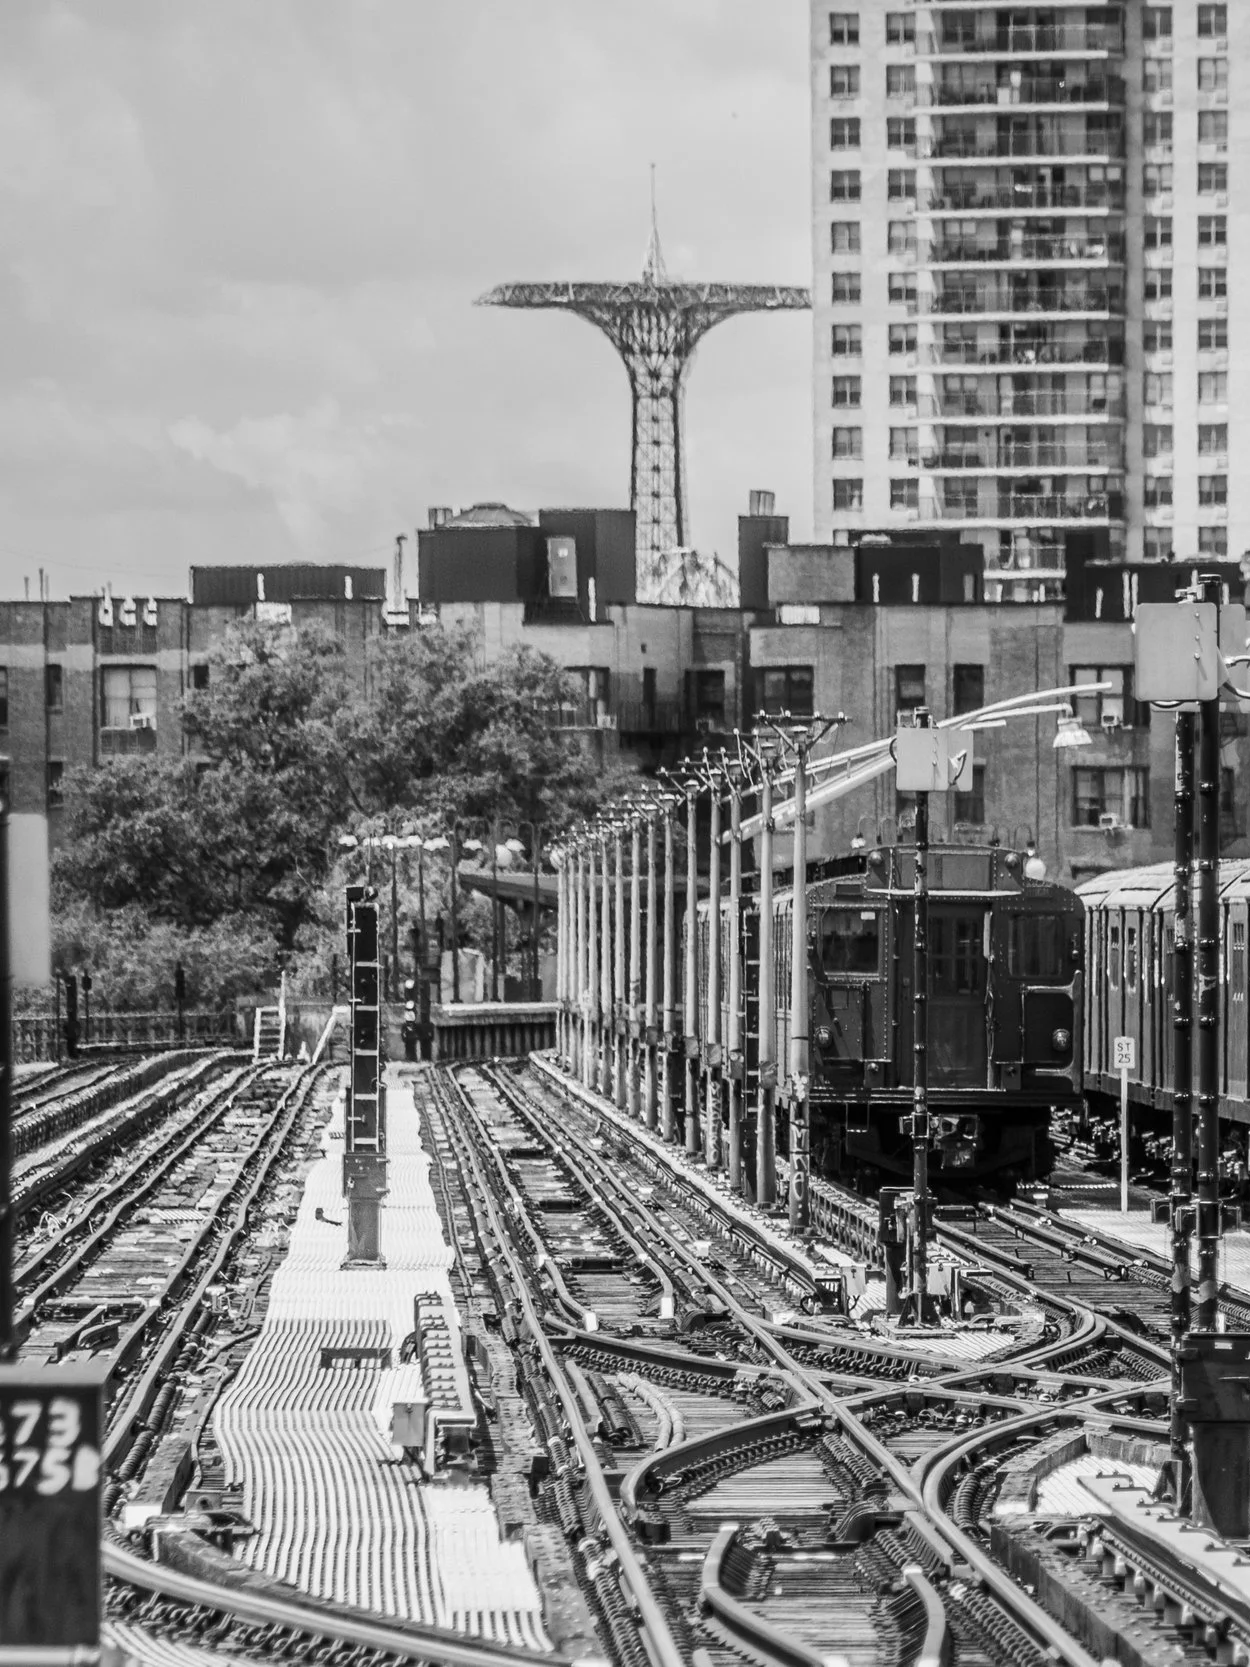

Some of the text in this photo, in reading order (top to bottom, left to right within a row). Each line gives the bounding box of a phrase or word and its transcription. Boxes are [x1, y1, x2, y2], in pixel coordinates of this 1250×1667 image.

[1117, 1042, 1131, 1052] ST
[1118, 1053, 1131, 1063] 25
[0, 1399, 81, 1446] 73
